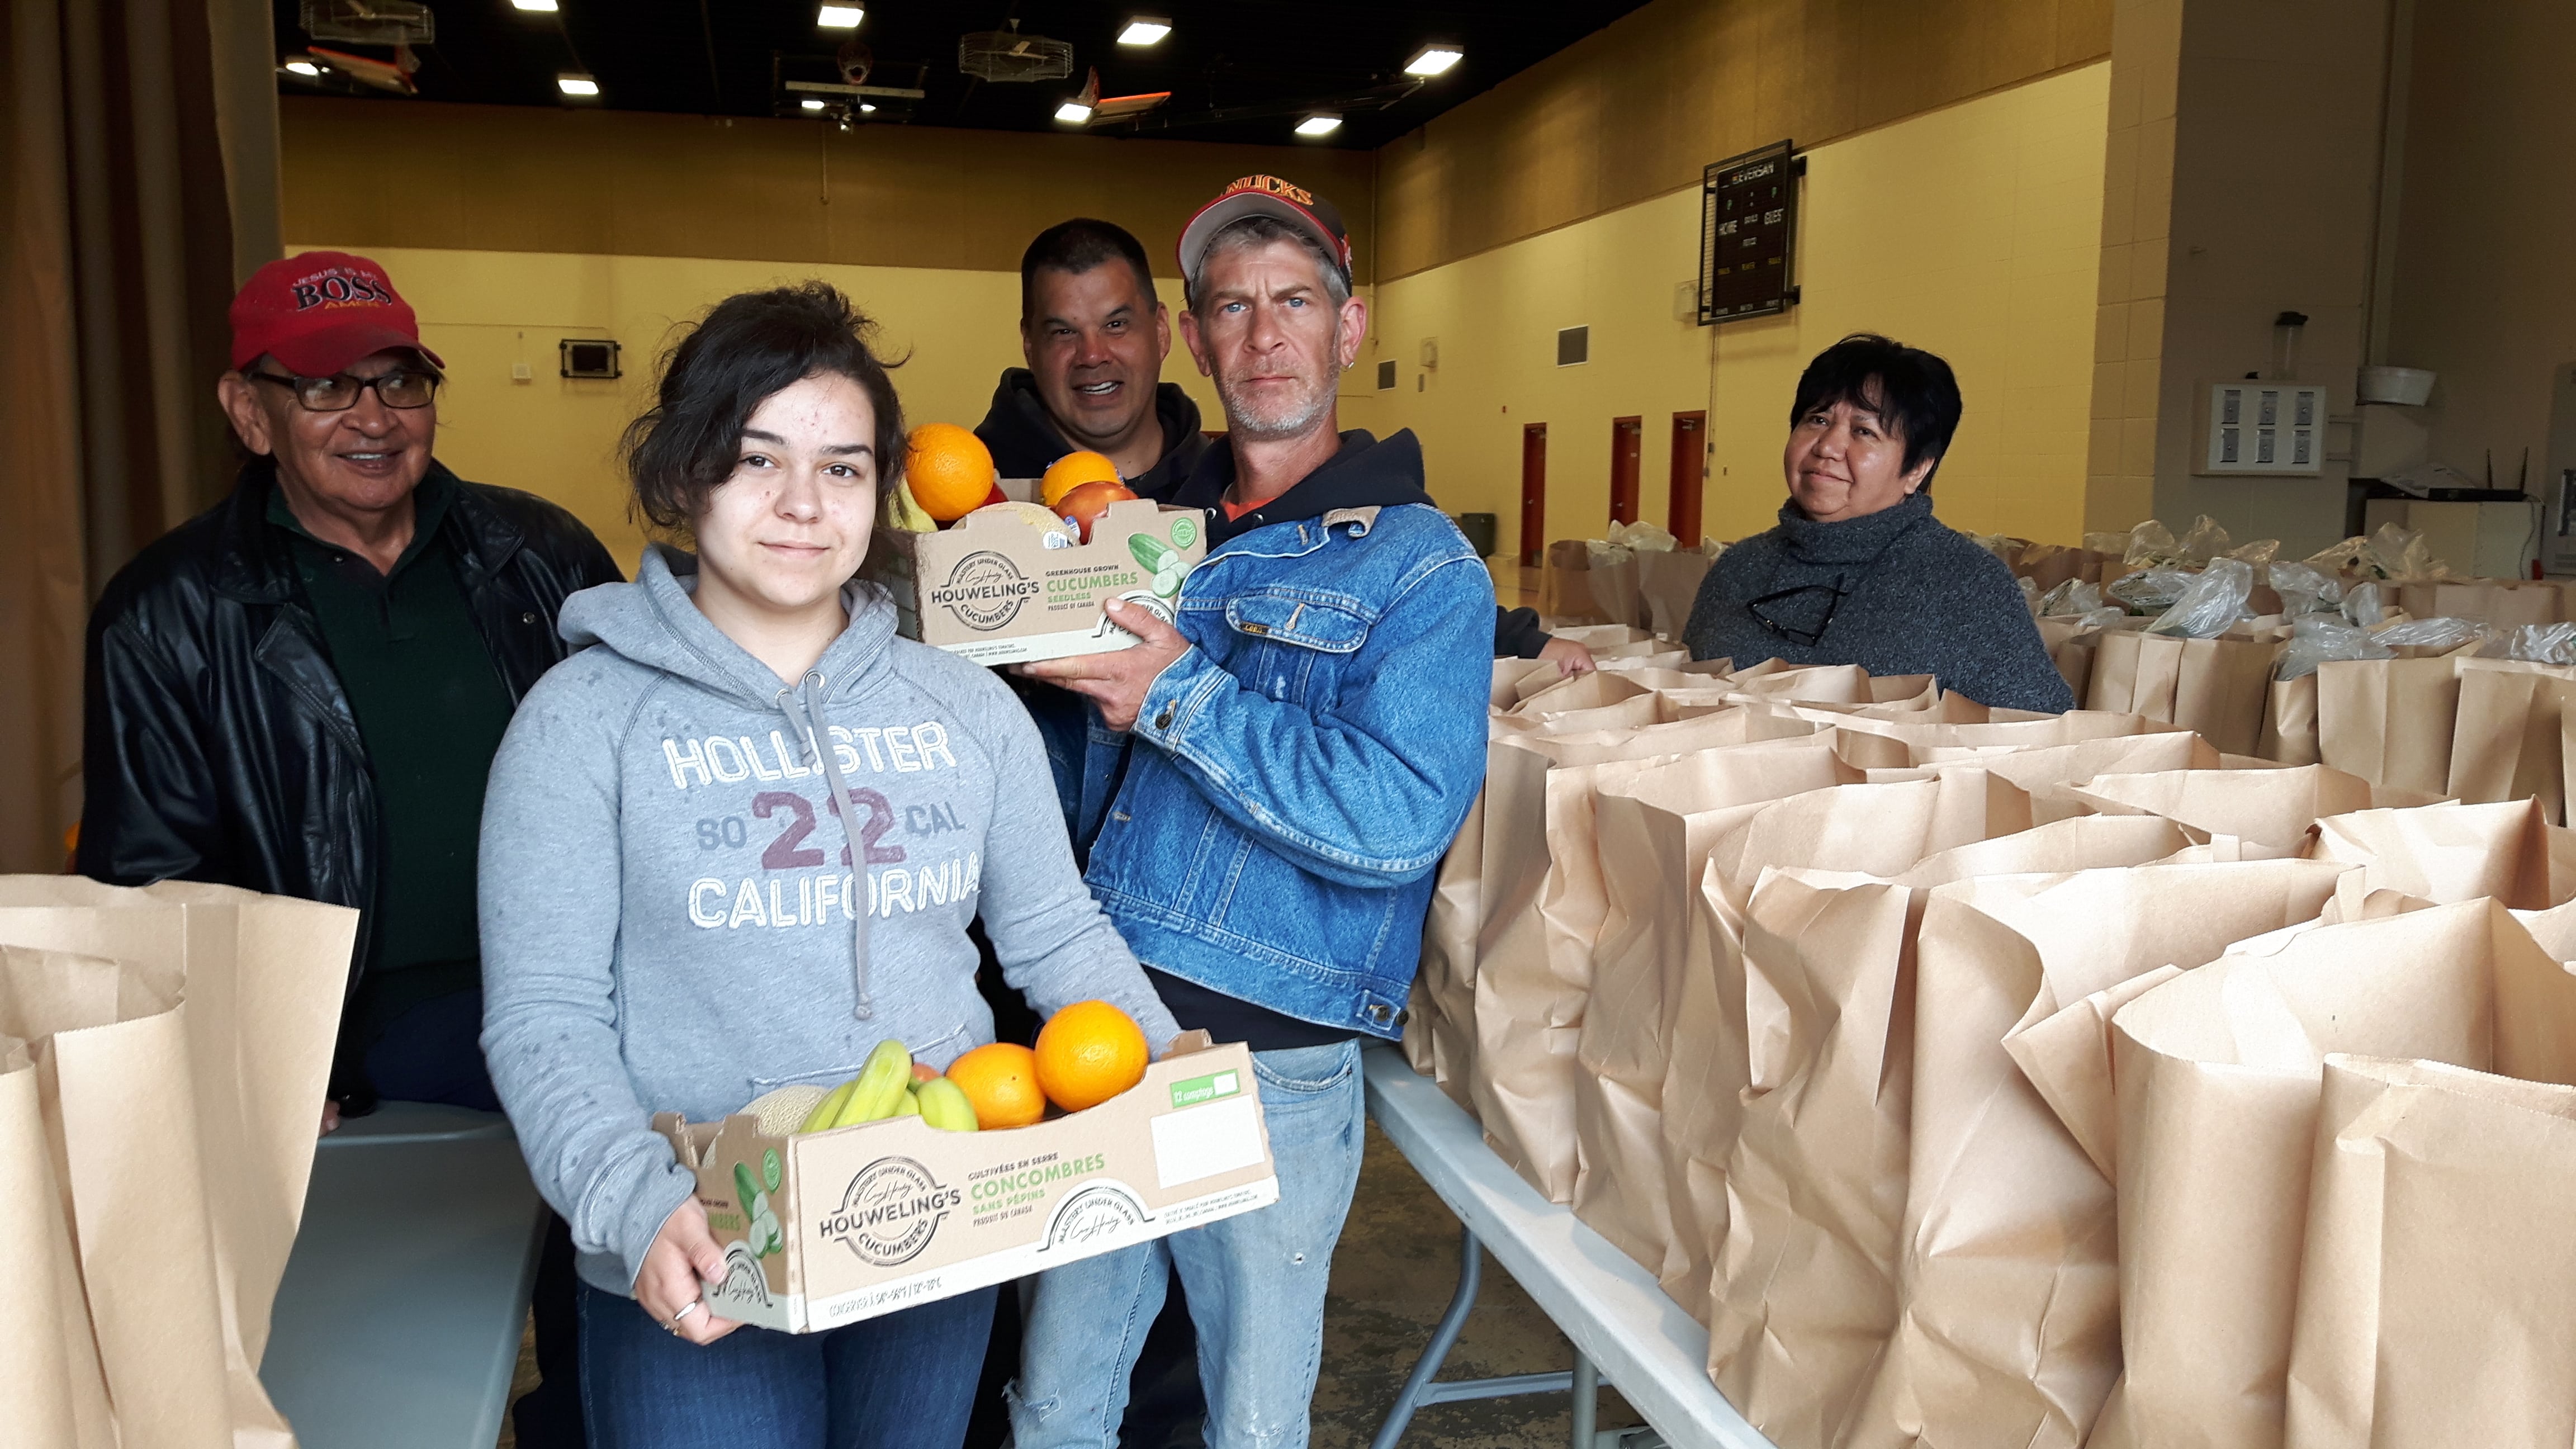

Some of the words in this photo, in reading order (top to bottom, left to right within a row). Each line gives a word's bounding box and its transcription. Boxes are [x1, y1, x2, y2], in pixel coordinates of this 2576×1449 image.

[1220, 174, 1314, 206] NUCKS
[290, 277, 392, 312] BOSS
[956, 561, 976, 584] MASTERY
[978, 558, 998, 566] UNDER
[998, 562, 1014, 580] GLASS
[1045, 566, 1092, 577] GREENHOUSE
[1093, 564, 1119, 572] GROWN
[1046, 571, 1138, 593] CUCUMBERS
[931, 581, 1040, 604] HOUWELING'S
[1048, 592, 1091, 603] SEEDLESS
[960, 599, 1014, 624] CUCUMBERS
[662, 720, 958, 789] HOLLISTER
[695, 816, 749, 851] SO
[751, 787, 908, 870] 22
[904, 801, 967, 835] CAL
[688, 851, 982, 929] CALIFORNIA
[968, 1163, 1015, 1181] CULTIVÉES
[1017, 1159, 1029, 1169] EN
[1031, 1152, 1059, 1166] SERRE
[971, 1153, 1105, 1200] CONCOMBRES
[820, 1188, 962, 1238] HOUWELING'S
[972, 1199, 1003, 1215] SANS
[1006, 1188, 1046, 1205] PÉPINS
[1114, 1201, 1135, 1225] GLASS
[859, 1218, 929, 1256] CUCUMBERS
